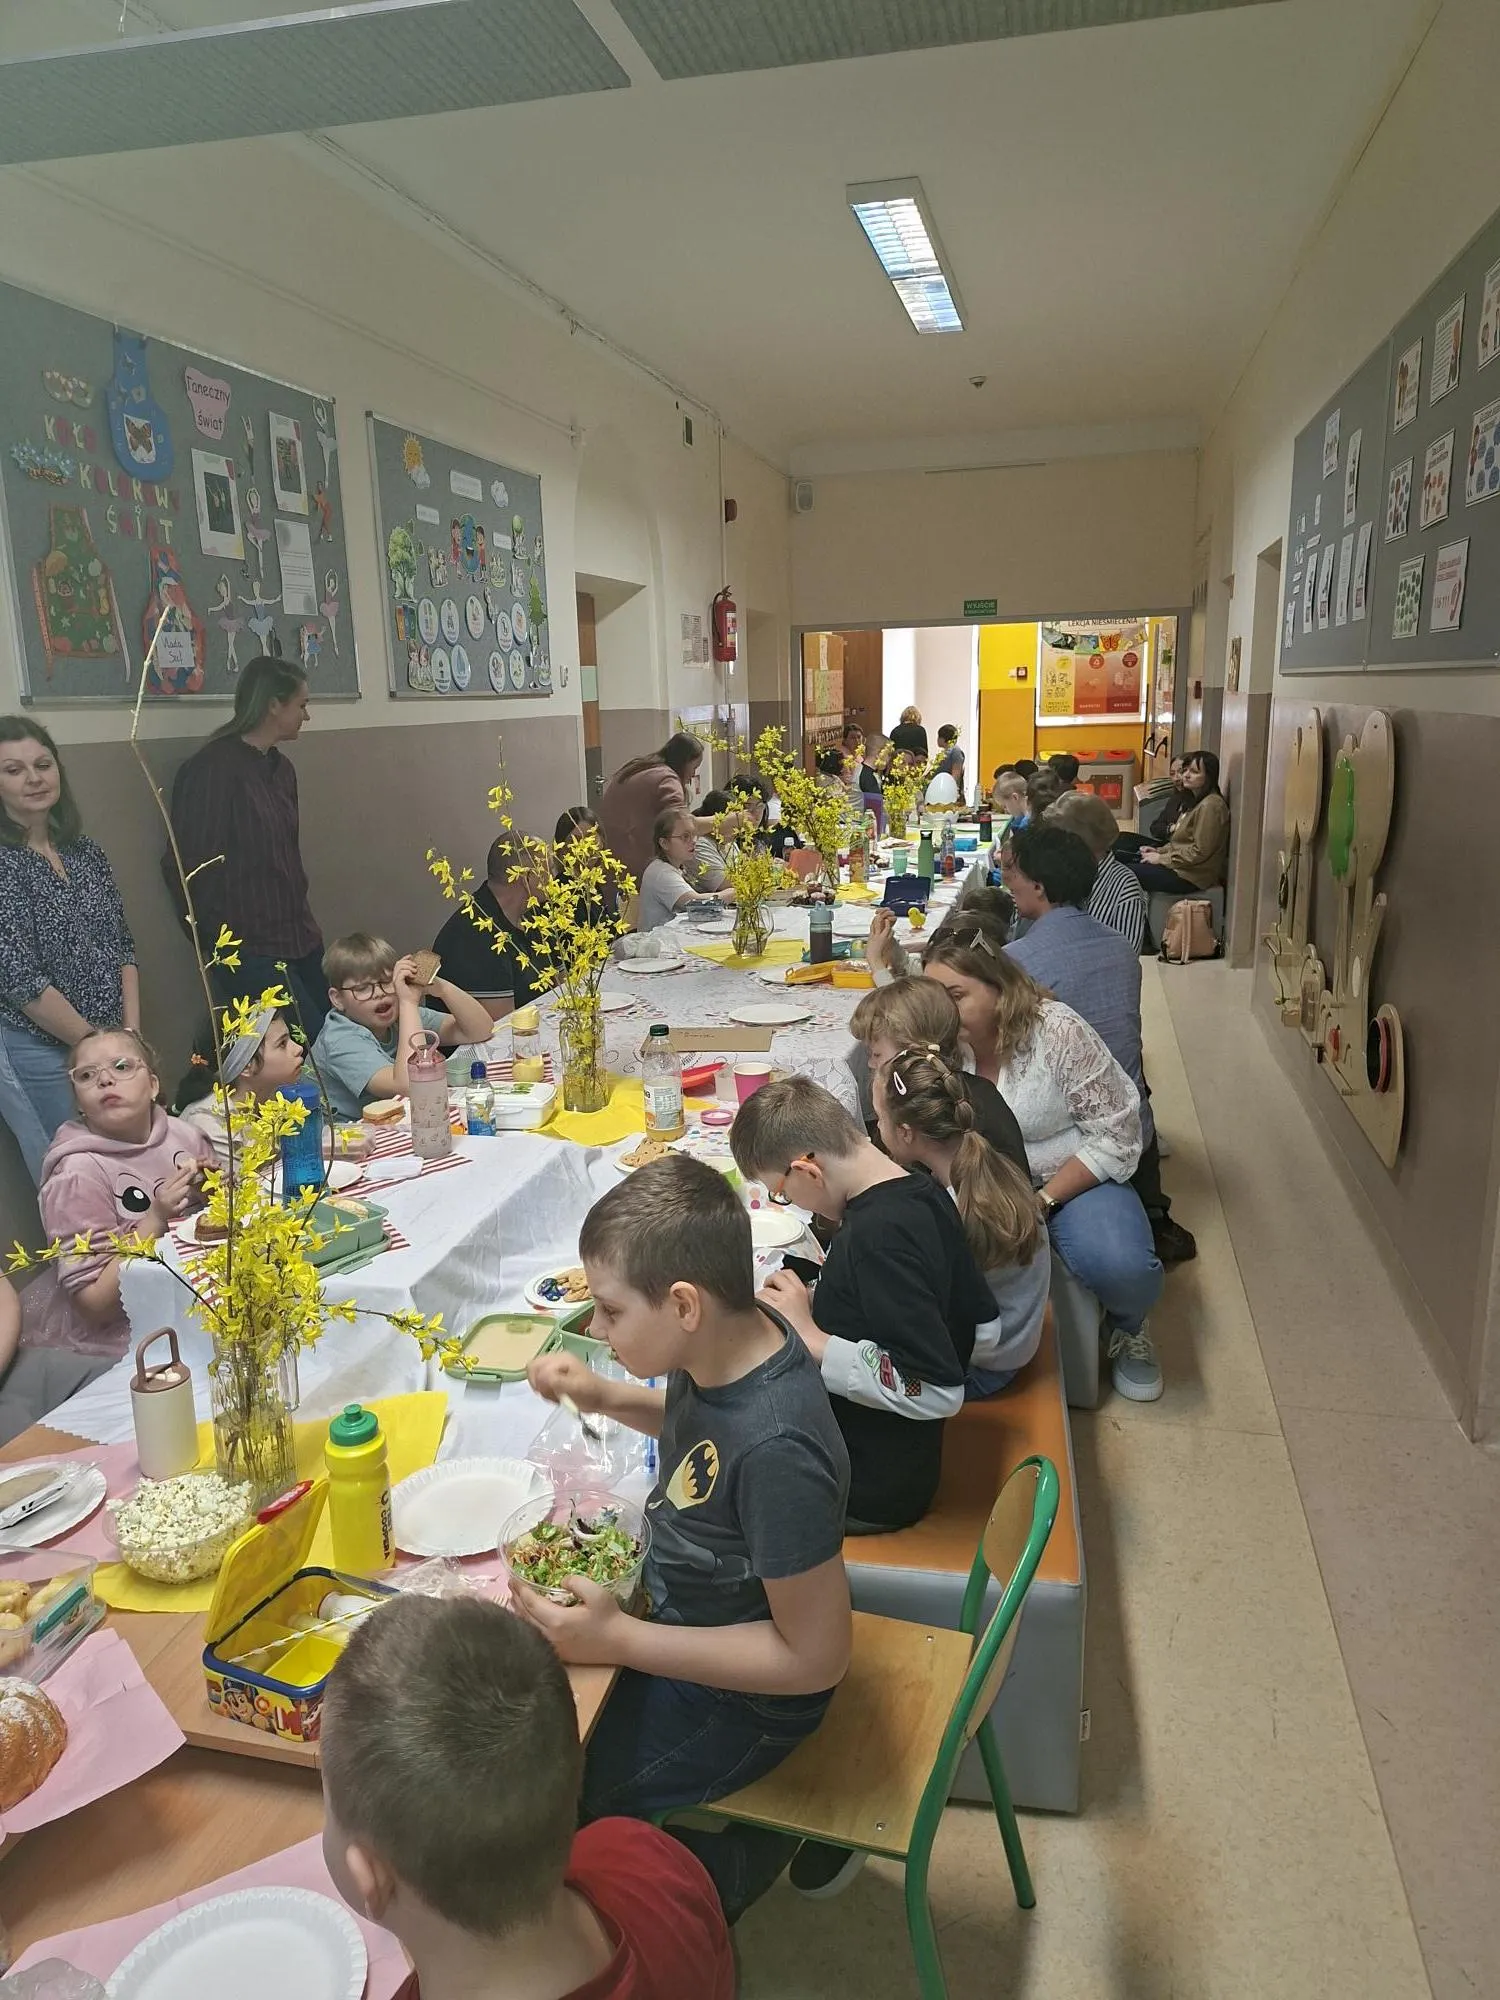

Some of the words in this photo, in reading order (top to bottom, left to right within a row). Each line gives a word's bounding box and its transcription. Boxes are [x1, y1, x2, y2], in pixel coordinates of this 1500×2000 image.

[187, 375, 231, 407] Taneczny
[197, 410, 223, 430] świat
[1067, 617, 1090, 627] LEKCJA
